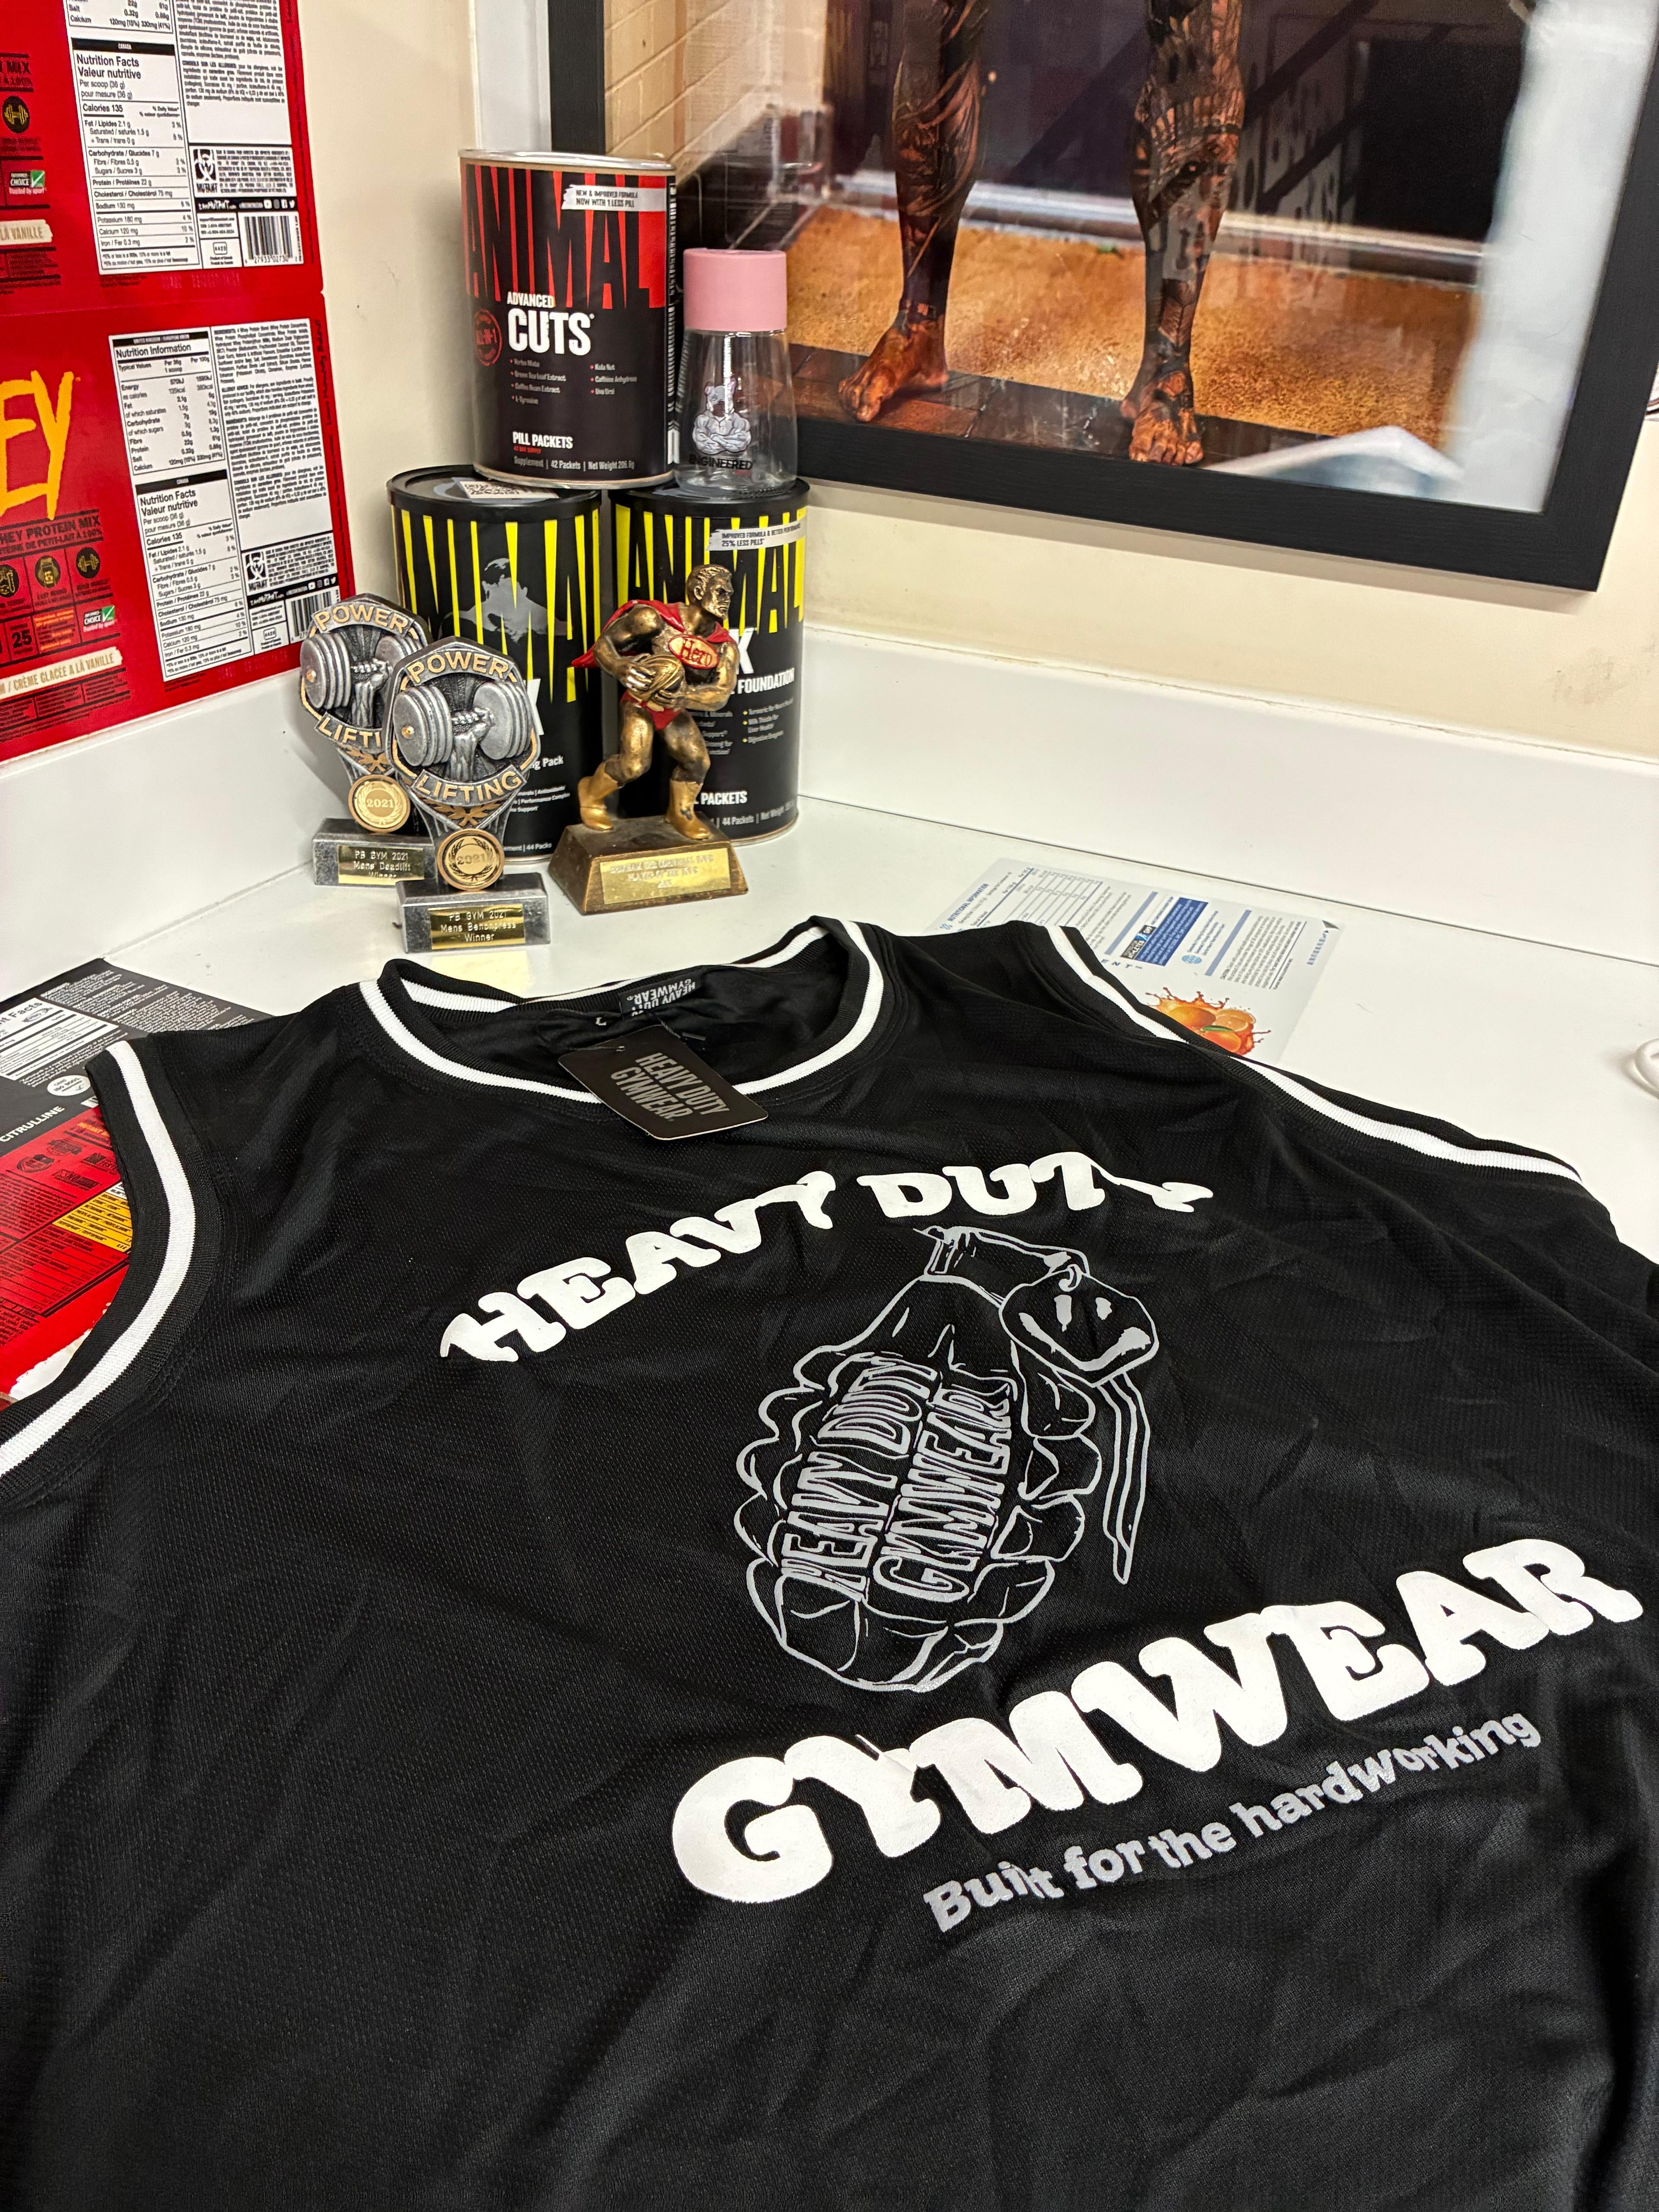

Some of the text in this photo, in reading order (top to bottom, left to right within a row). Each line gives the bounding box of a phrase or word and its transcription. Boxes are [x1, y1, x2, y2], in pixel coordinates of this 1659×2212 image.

[70, 15, 91, 23] Calcium
[76, 54, 140, 67] Nutrition Facts
[77, 66, 141, 79] Valeur nutritive
[79, 79, 108, 89] Per scoop
[83, 103, 123, 112] Calories 135
[98, 120, 117, 128] Lipides
[88, 149, 124, 157] Carbohydrate
[611, 199, 624, 207] LESS
[625, 200, 635, 208] PILL
[11, 226, 42, 240] VANILLE
[507, 290, 556, 308] ADVANCED
[508, 308, 591, 356] CUTS
[116, 343, 191, 359] Nutrition Information
[512, 431, 573, 449] PILL PACKETS
[559, 460, 581, 470] Packets
[588, 460, 598, 470] Net
[599, 461, 617, 471] Weight
[688, 453, 753, 470] ENGINEERED
[140, 489, 196, 507] Nutrition Facts
[141, 498, 198, 517] Valeur nutritive
[25, 520, 76, 539] PROTEIN
[77, 515, 102, 528] MIX
[146, 533, 183, 546] Calories 135
[314, 603, 409, 634] POWER
[11, 630, 33, 648] 25
[86, 653, 114, 670] VANILLE
[406, 651, 509, 683] POWER
[737, 667, 795, 695] FOUNDATION
[318, 716, 382, 750] LIFTI
[542, 755, 564, 768] Pack
[415, 770, 523, 802] LIFTING
[366, 798, 394, 809] 2021
[701, 790, 748, 805] PACKETS
[721, 817, 731, 826] 44
[731, 815, 755, 825] Packets
[535, 842, 552, 850] Packs
[392, 852, 409, 861] 2021
[457, 854, 485, 865] 2021
[353, 861, 411, 872] Mens Deadlift
[449, 909, 507, 922] PB GYM 2021
[441, 922, 463, 933] Mens
[464, 932, 495, 942] Winner
[662, 981, 696, 1005] HEAVY
[8, 1002, 42, 1018] Facts
[635, 1052, 730, 1115] HEAVY DUTY
[0, 1106, 65, 1142] CITRULLINE
[440, 1151, 1214, 1363] HEAVY DUTY
[780, 1356, 938, 1601] HEAVY DUTY
[873, 1382, 1012, 1603] GYMWEAR
[671, 1537, 1643, 1905] GYMWEAR
[923, 1712, 1541, 1933] Built for the hardworking
